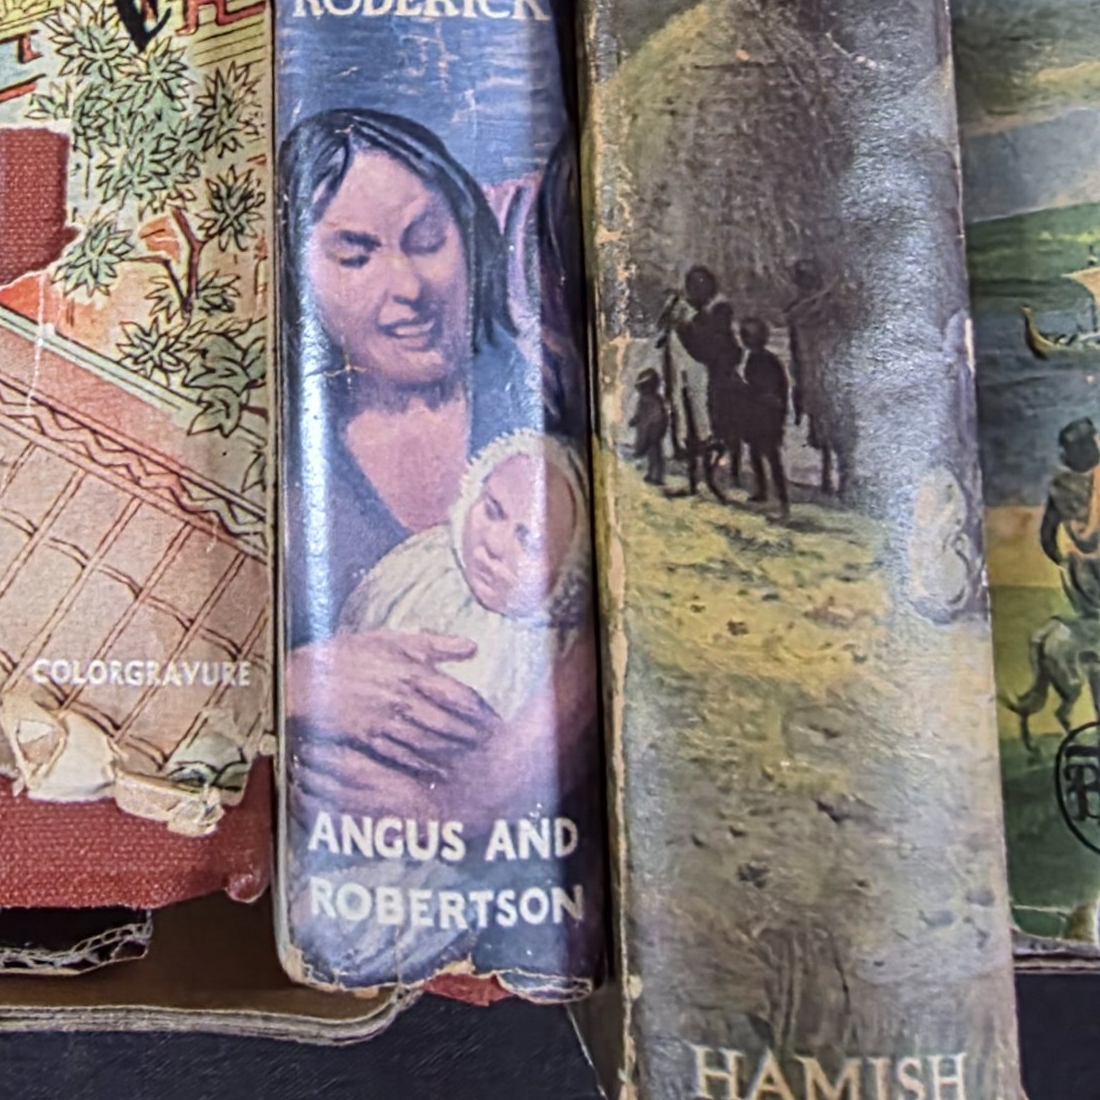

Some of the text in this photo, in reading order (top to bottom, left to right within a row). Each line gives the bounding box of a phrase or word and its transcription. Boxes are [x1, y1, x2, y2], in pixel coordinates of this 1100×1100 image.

[31, 658, 252, 687] COLORGRAVURE
[309, 813, 579, 861] ANGUS AND
[309, 878, 584, 928] ROBERTSON
[685, 1040, 967, 1100] HAMISH
